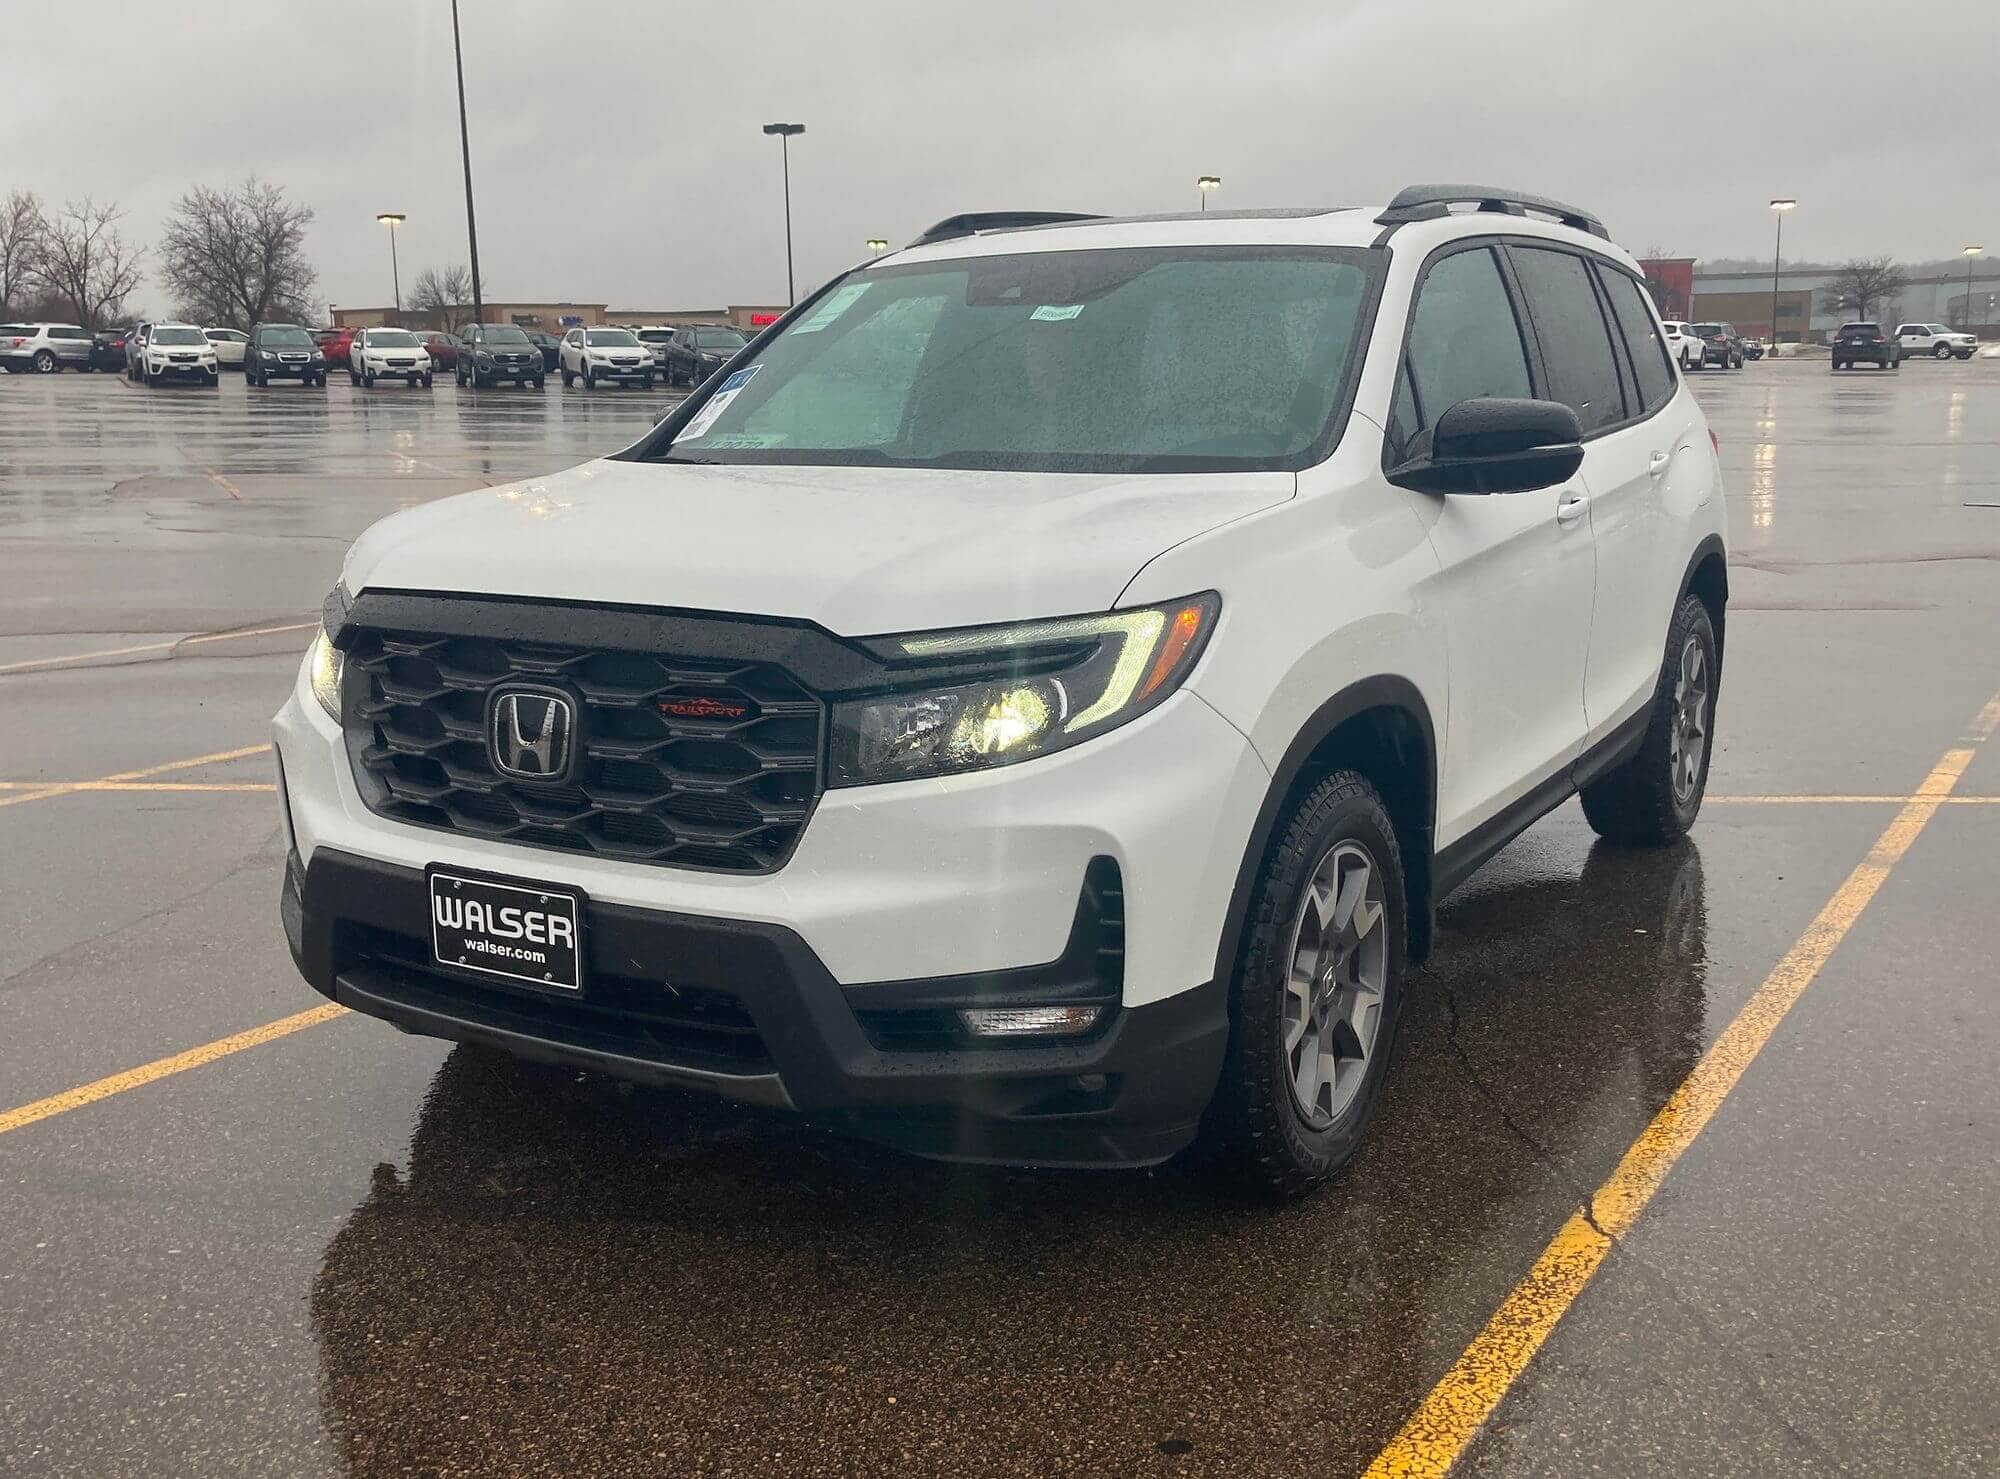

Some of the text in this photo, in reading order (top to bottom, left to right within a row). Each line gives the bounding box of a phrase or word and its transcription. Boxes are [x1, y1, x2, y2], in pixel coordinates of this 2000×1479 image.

[658, 703, 746, 718] TRAILSPORT
[434, 895, 573, 949] WALSER
[464, 938, 546, 964] walser.com
